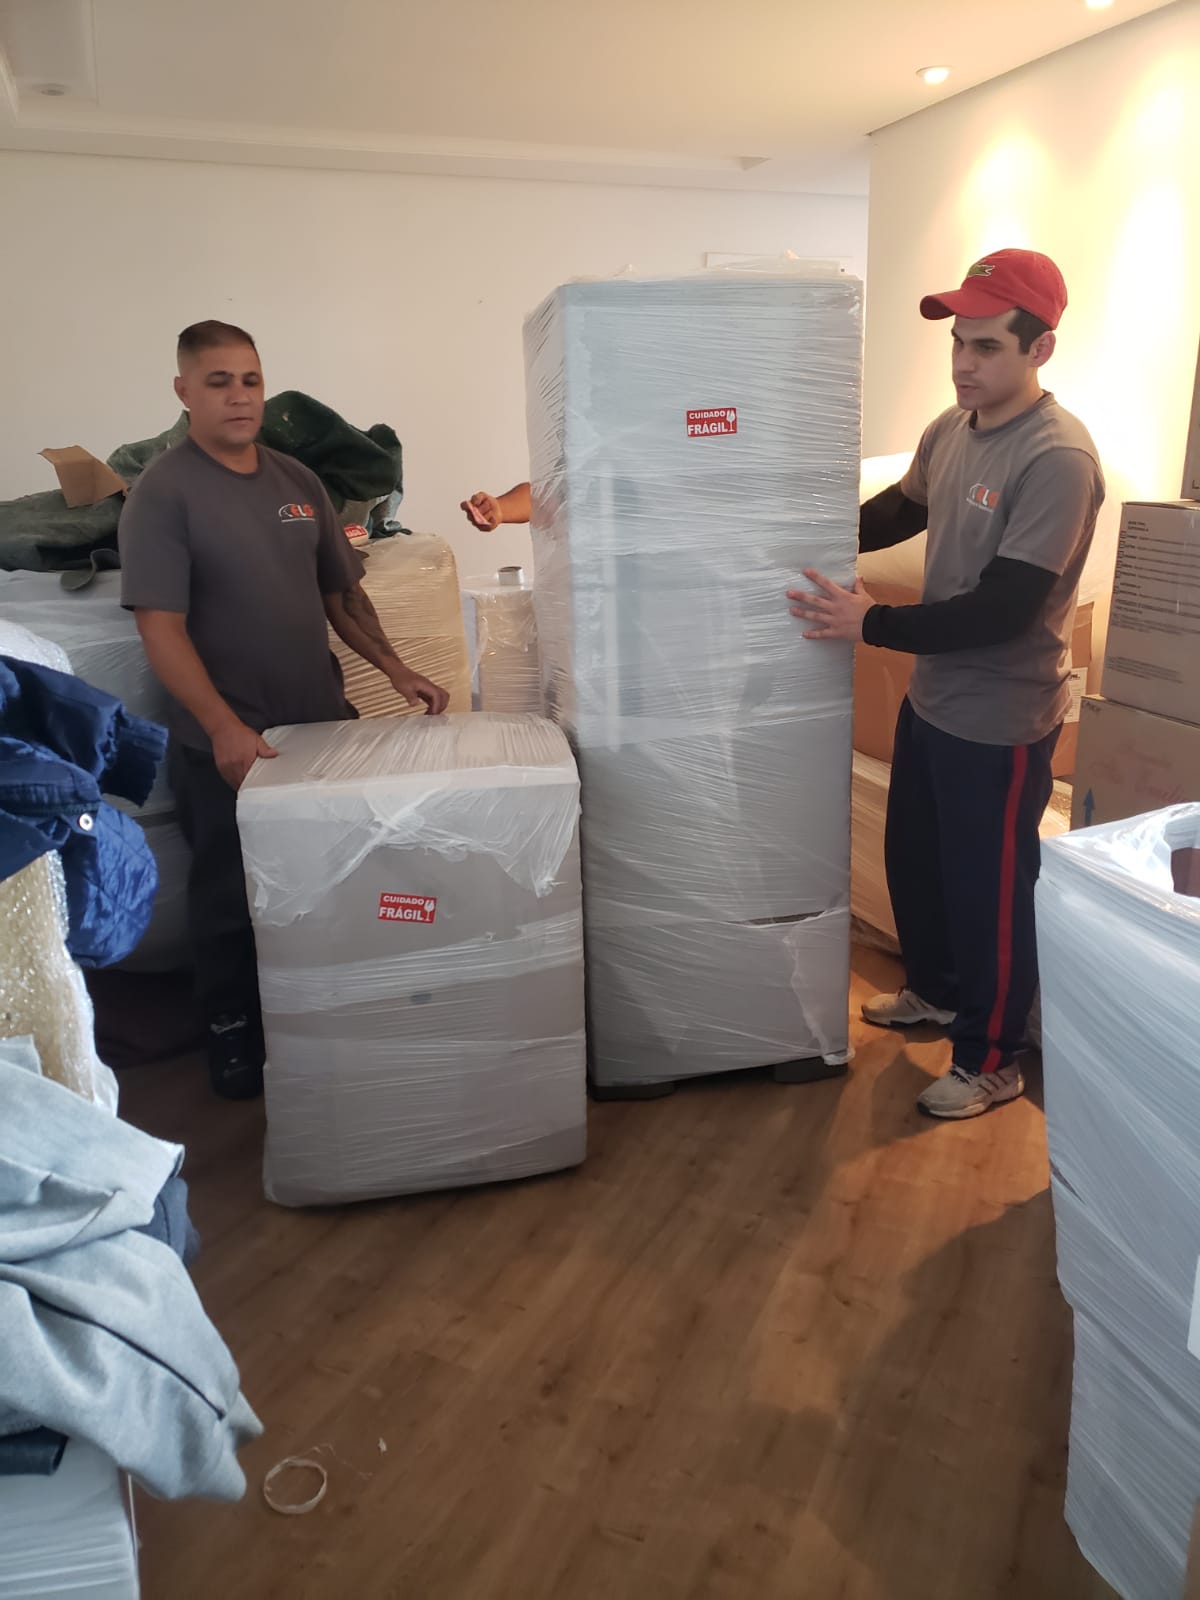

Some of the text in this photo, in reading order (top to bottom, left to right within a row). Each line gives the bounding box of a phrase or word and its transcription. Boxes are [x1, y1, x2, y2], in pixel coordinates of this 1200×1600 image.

[689, 410, 726, 420] CUIDADO
[687, 420, 728, 435] FRÁGIL
[383, 895, 425, 906] CUIDADO
[378, 905, 425, 921] FRÁGIL
